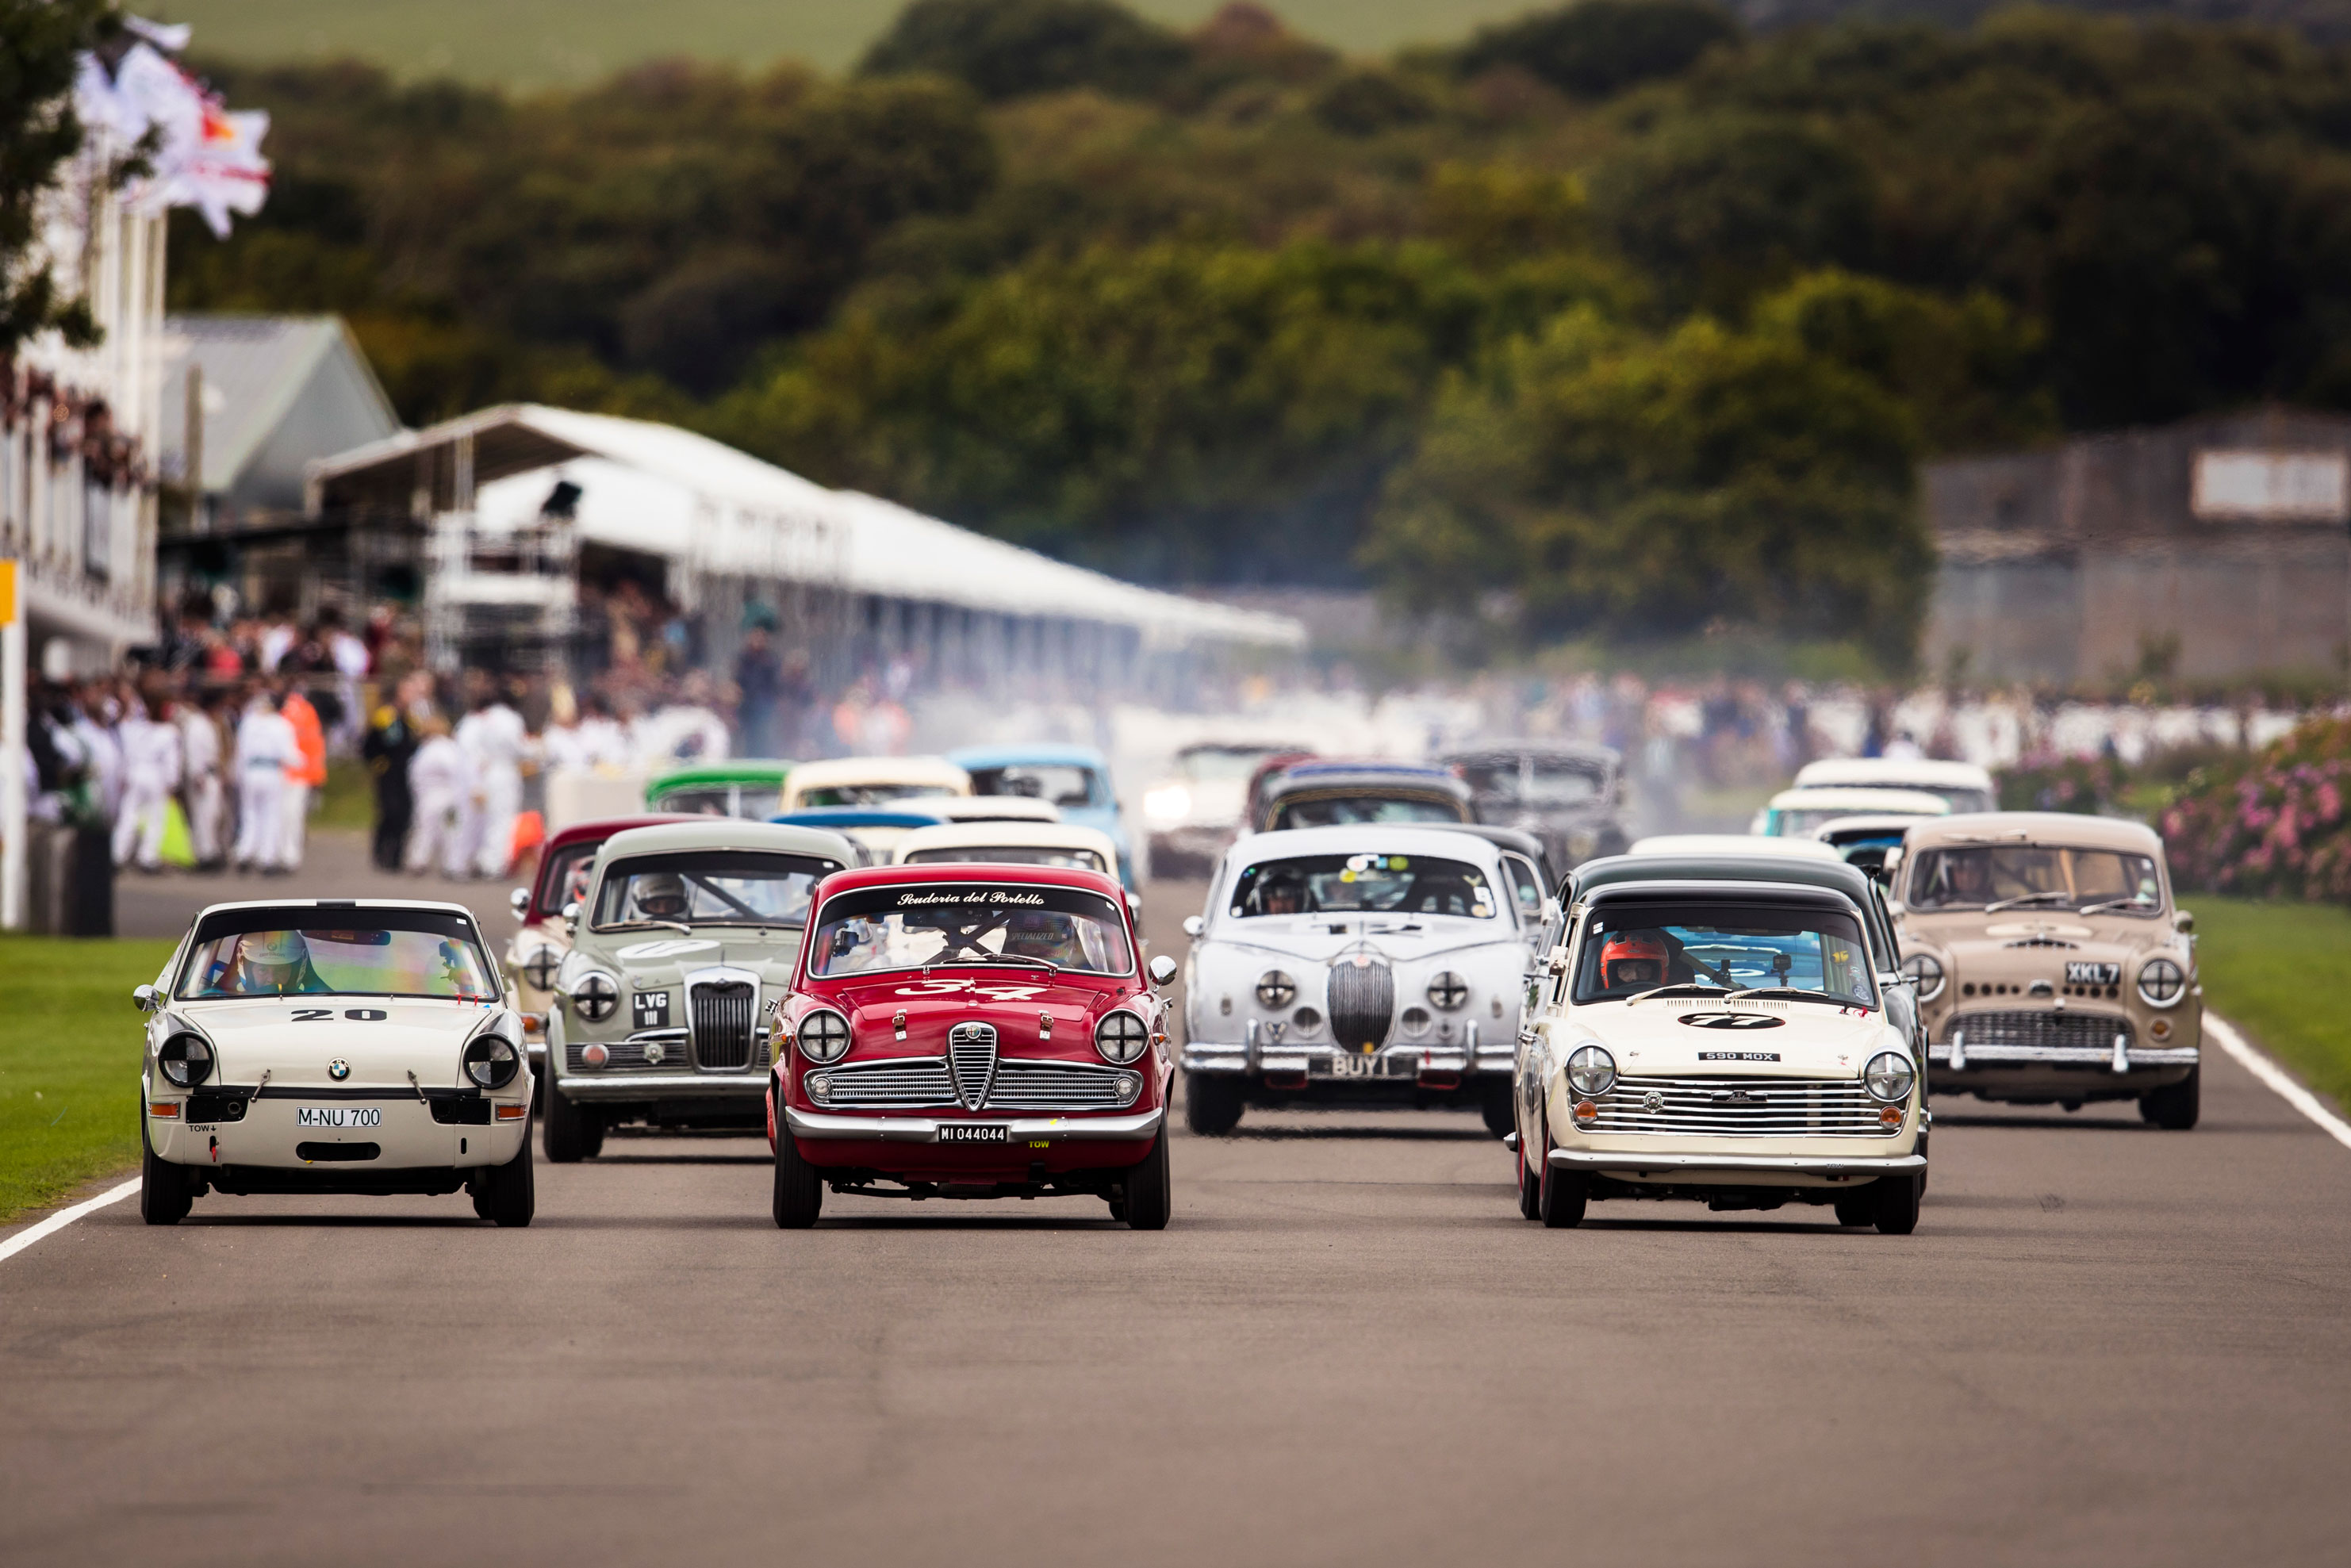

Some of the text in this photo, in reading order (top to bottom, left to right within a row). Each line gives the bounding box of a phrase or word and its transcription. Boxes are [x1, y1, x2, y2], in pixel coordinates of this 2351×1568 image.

[897, 891, 1045, 906] Scuderia del Portello
[895, 980, 1047, 1000] 34
[635, 994, 667, 1010] LVG
[290, 1009, 387, 1022] 20
[1689, 1014, 1774, 1026] 77
[1743, 1052, 1774, 1061] MOX
[298, 1109, 381, 1126] M-NU 700
[957, 1128, 1004, 1140] 044044
